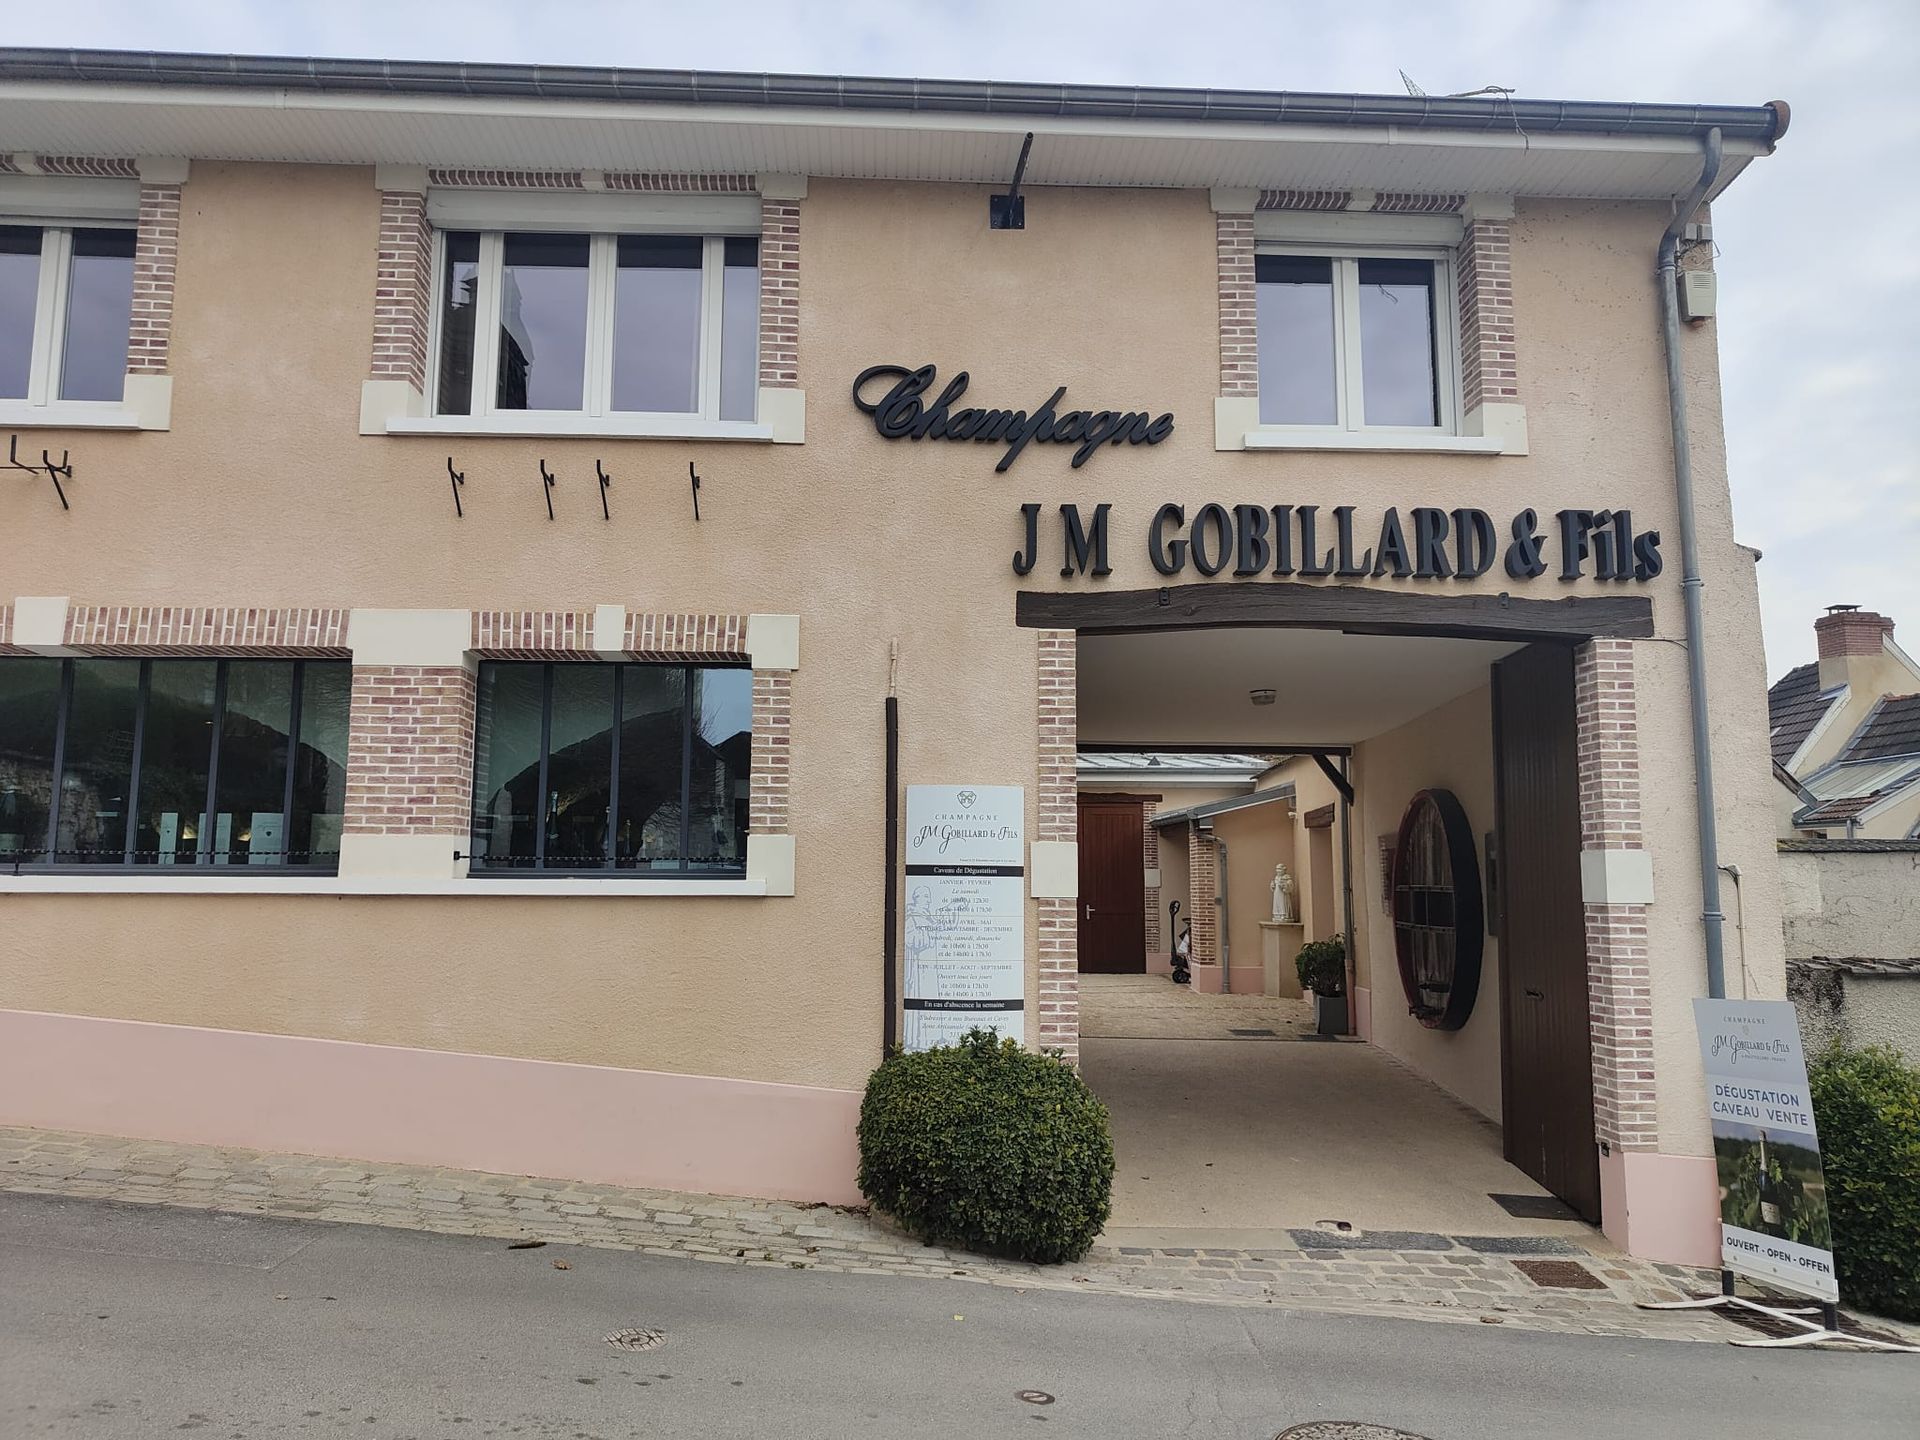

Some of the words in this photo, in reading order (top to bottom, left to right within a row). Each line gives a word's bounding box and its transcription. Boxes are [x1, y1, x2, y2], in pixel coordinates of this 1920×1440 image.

[852, 364, 1174, 473] Champagne
[1148, 502, 1497, 579] GOBILLARD
[1504, 507, 1548, 581] &
[1555, 508, 1663, 582] Fils
[939, 824, 988, 854] GOBILLARD
[1723, 1016, 1765, 1024] CHAMPAGNE
[1715, 1084, 1800, 1107] DÉGUSTATION
[1713, 1101, 1760, 1119] CAVEAU
[1766, 1108, 1809, 1126] VENTE
[1726, 1236, 1760, 1254] OUVERT
[1767, 1248, 1791, 1263] OPEN
[1799, 1257, 1830, 1274] OFFEN
